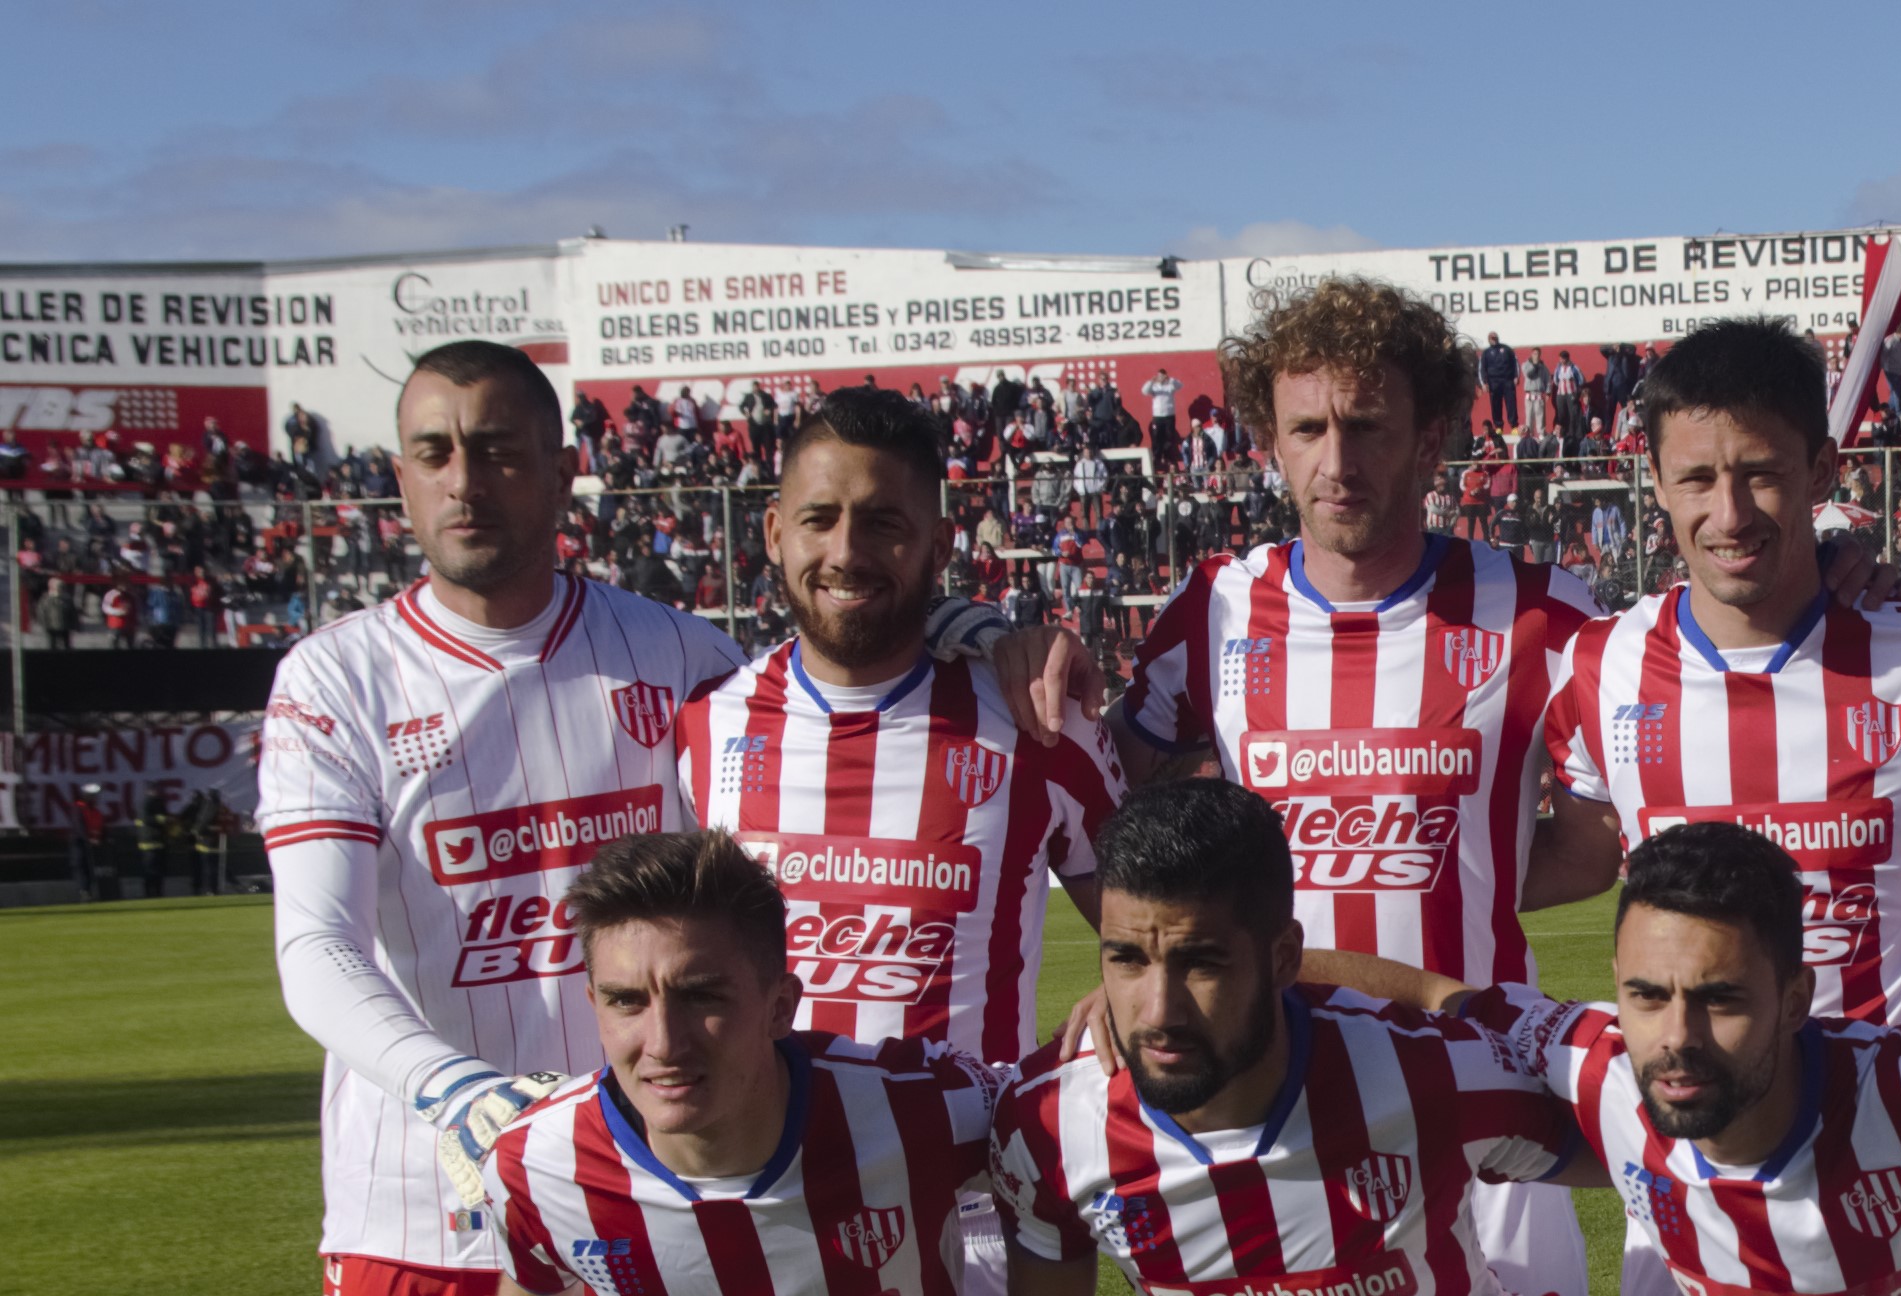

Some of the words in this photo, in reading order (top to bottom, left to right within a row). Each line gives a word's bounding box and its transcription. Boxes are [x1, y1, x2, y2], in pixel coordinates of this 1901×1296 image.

[1429, 248, 1578, 281] TALLER
[1604, 244, 1657, 273] DE
[390, 271, 530, 315] Control
[597, 280, 671, 307] UNICO
[683, 277, 713, 304] EN
[725, 273, 805, 302] SANTA
[816, 270, 848, 296] FE
[1431, 289, 1538, 315] OBLEAS
[1553, 279, 1729, 310] NACIONALES
[1765, 274, 1865, 301] PAISES
[101, 292, 147, 324] DE
[161, 294, 335, 327] REVISION
[394, 313, 529, 337] vehicular
[600, 311, 700, 341] OBLEAS
[712, 302, 880, 336] NACIONALES
[906, 295, 1005, 325] PAISES
[1018, 285, 1181, 319] LIMITROFES
[131, 334, 336, 367] VEHICULAR
[601, 345, 654, 367] BLAS
[666, 339, 750, 364] PARERA
[762, 336, 826, 359] 10400
[969, 324, 1062, 348] 4895132
[1076, 318, 1182, 343] 4832292
[1451, 633, 1495, 674] CAU
[387, 712, 445, 740] TBS
[623, 692, 667, 730] CAU
[1852, 708, 1897, 748] CAU
[952, 750, 996, 794] CAU
[1291, 740, 1473, 784] @clubaunion
[488, 802, 658, 861] @clubaunion
[779, 847, 973, 893] @clubaunion
[1293, 853, 1432, 887] US
[797, 962, 922, 999] US
[1352, 1167, 1406, 1202] CAU
[844, 1221, 897, 1250] CAU
